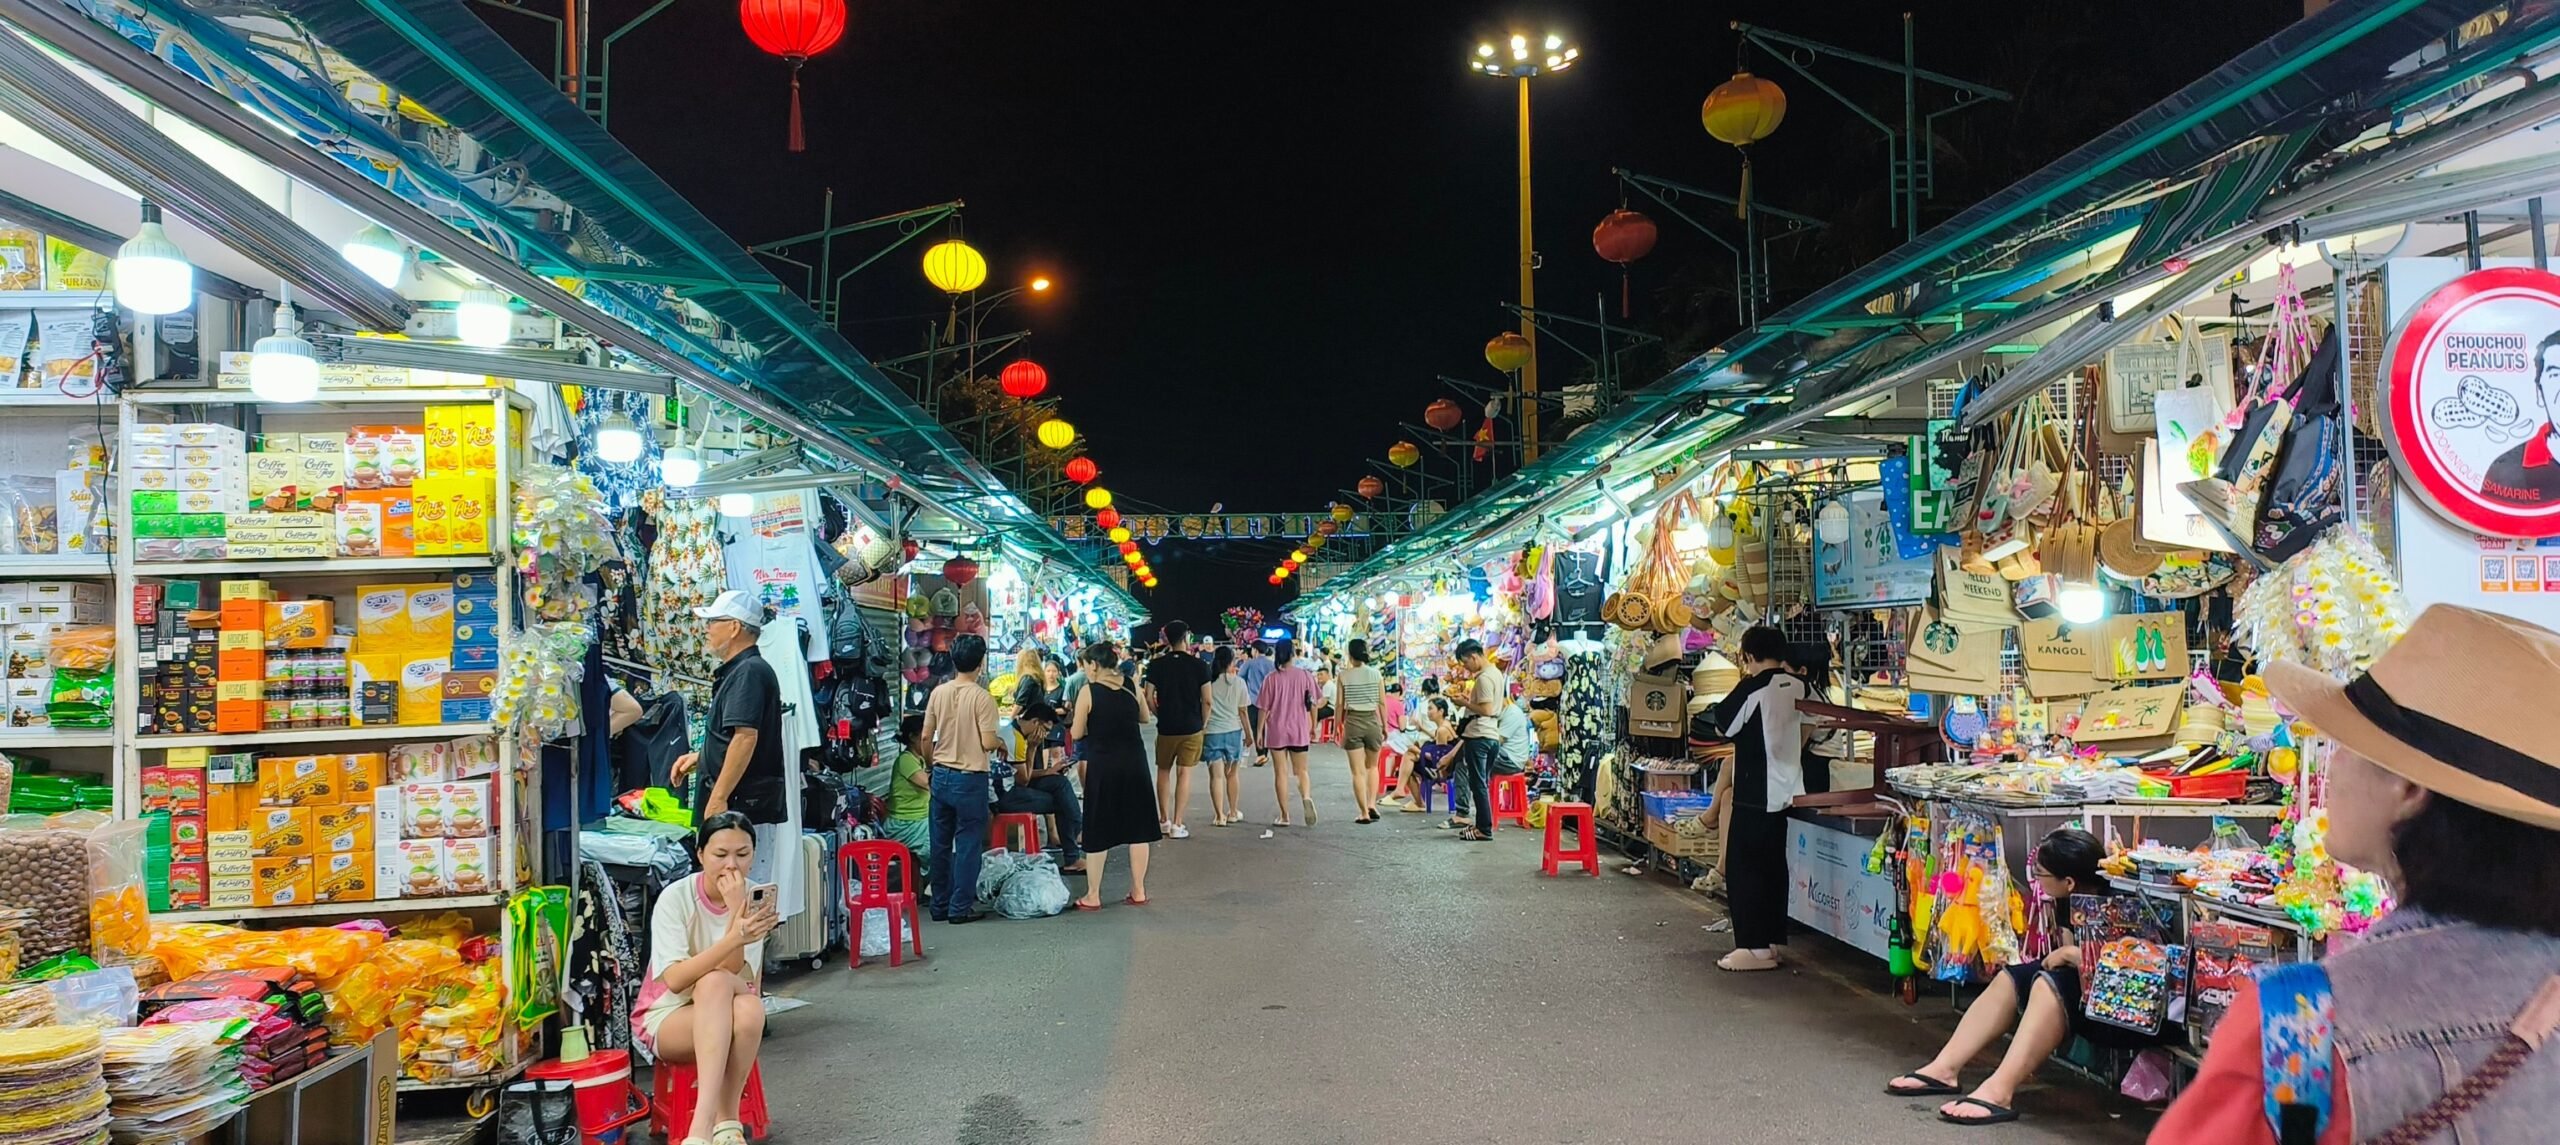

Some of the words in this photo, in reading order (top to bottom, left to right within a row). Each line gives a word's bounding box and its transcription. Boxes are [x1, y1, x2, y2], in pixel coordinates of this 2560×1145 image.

[2446, 335, 2523, 350] CHOUCHOU
[2448, 351, 2525, 369] PEANUTS
[2434, 429, 2482, 486] DOMINIQUE
[257, 458, 286, 470] Coffee
[304, 458, 333, 470] Coffee
[268, 469, 288, 479] Joy
[315, 469, 335, 479] Joy
[2483, 478, 2541, 500] SAMARINE
[235, 516, 254, 525] Coffee
[235, 531, 255, 540] Coffee
[285, 530, 304, 538] Coffee
[1963, 582, 2002, 597] WEEKEND
[2038, 645, 2087, 656] KANGOL
[284, 776, 310, 790] CRUNCH
[218, 864, 240, 872] Coffee
